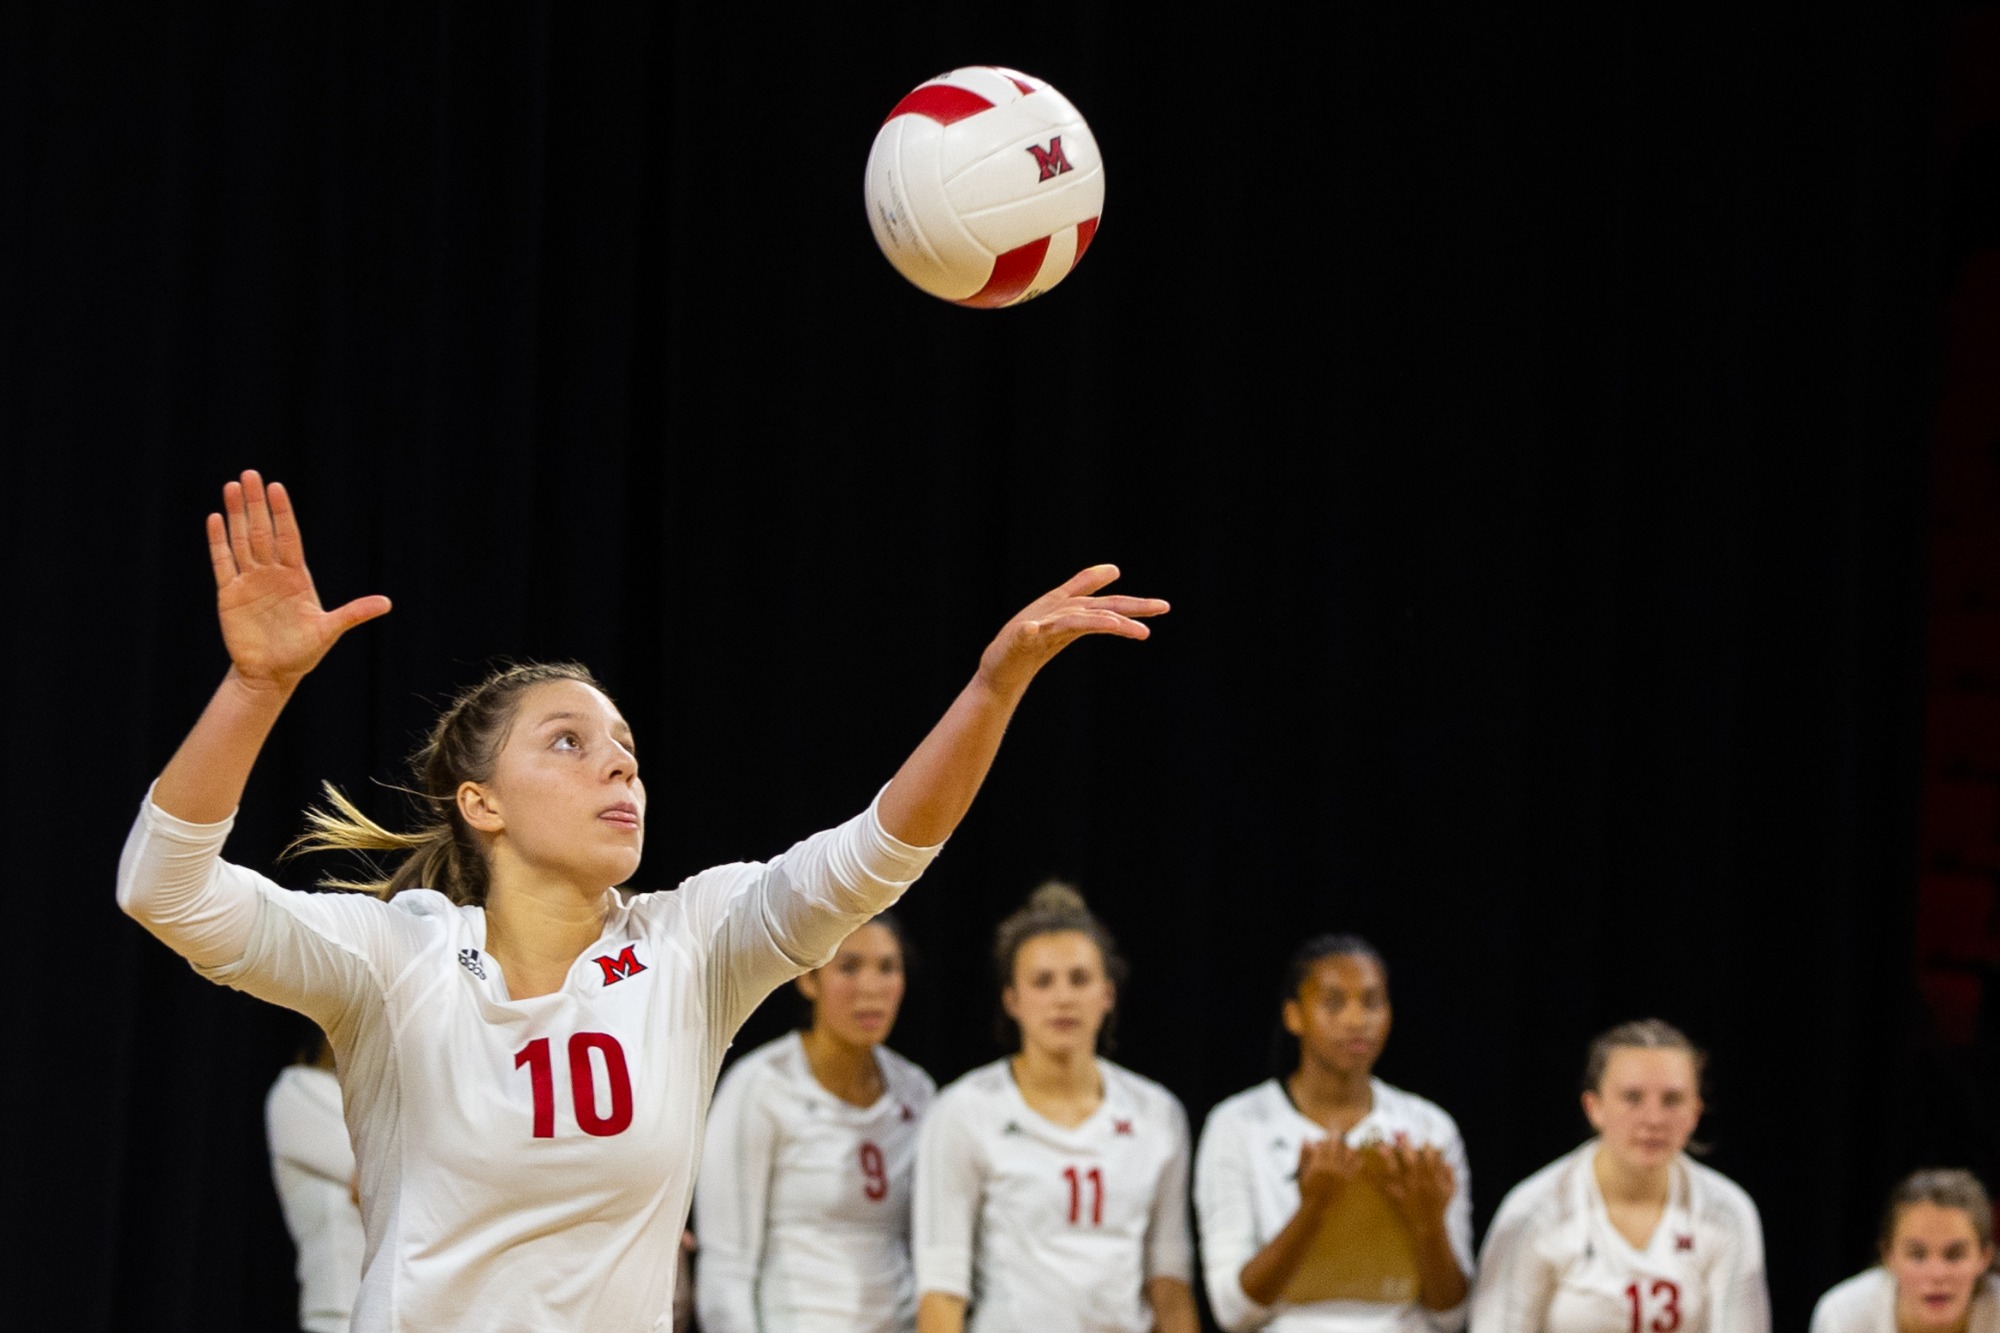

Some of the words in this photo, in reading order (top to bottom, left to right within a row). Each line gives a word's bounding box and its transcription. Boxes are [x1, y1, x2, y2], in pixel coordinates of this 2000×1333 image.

[1026, 135, 1074, 183] M
[457, 952, 487, 981] didas
[591, 943, 649, 988] M
[514, 1031, 634, 1138] 10
[859, 1141, 888, 1202] 9
[1063, 1166, 1103, 1227] 11
[1624, 1278, 1682, 1333] 13
